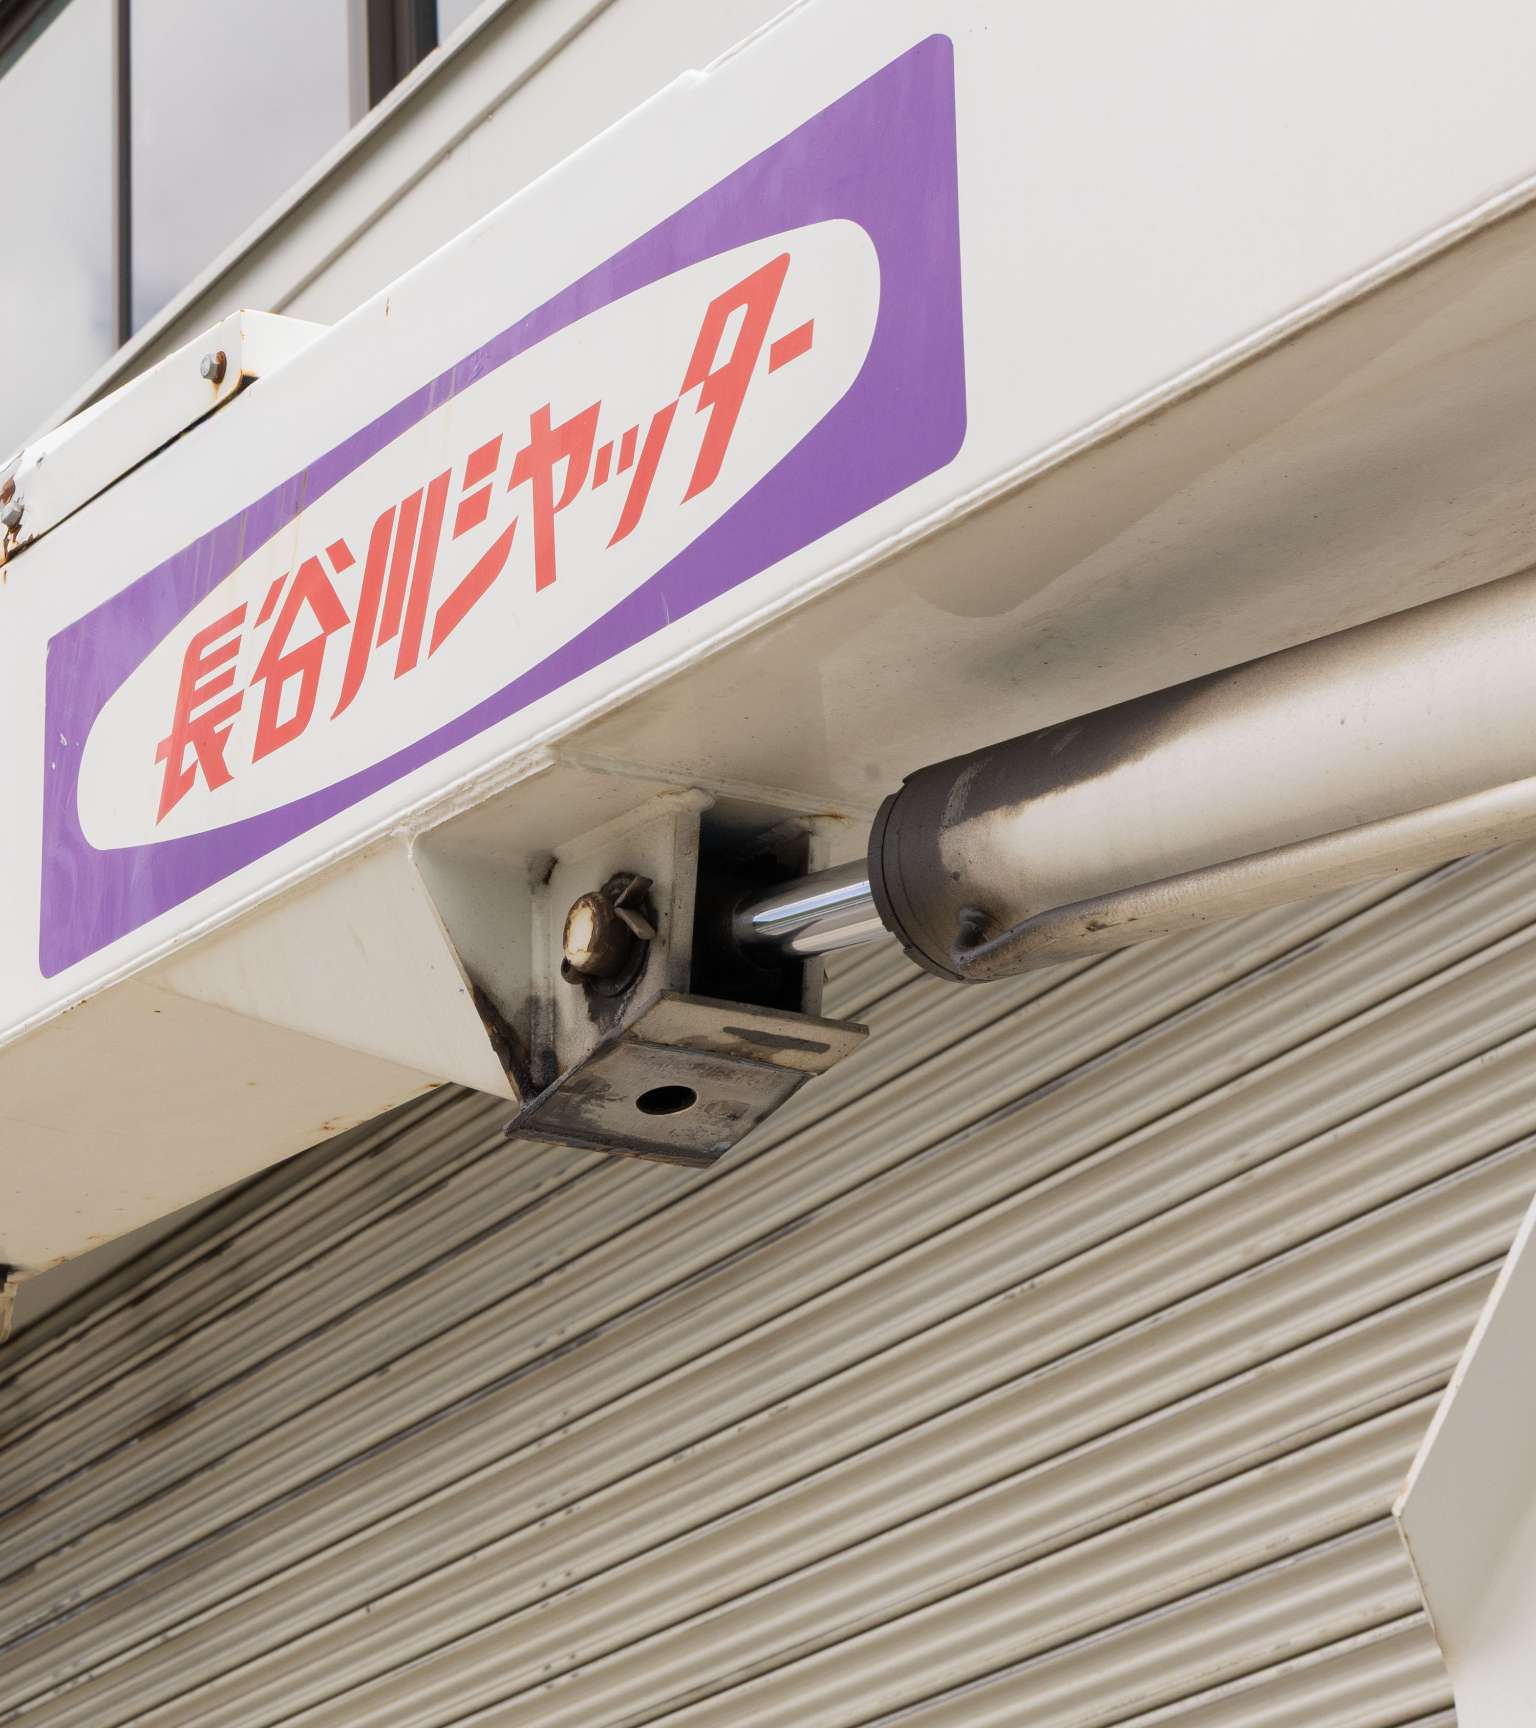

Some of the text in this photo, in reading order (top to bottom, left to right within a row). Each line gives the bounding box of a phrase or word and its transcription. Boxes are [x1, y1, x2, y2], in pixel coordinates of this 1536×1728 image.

[155, 252, 815, 826] 長谷川シャッター
